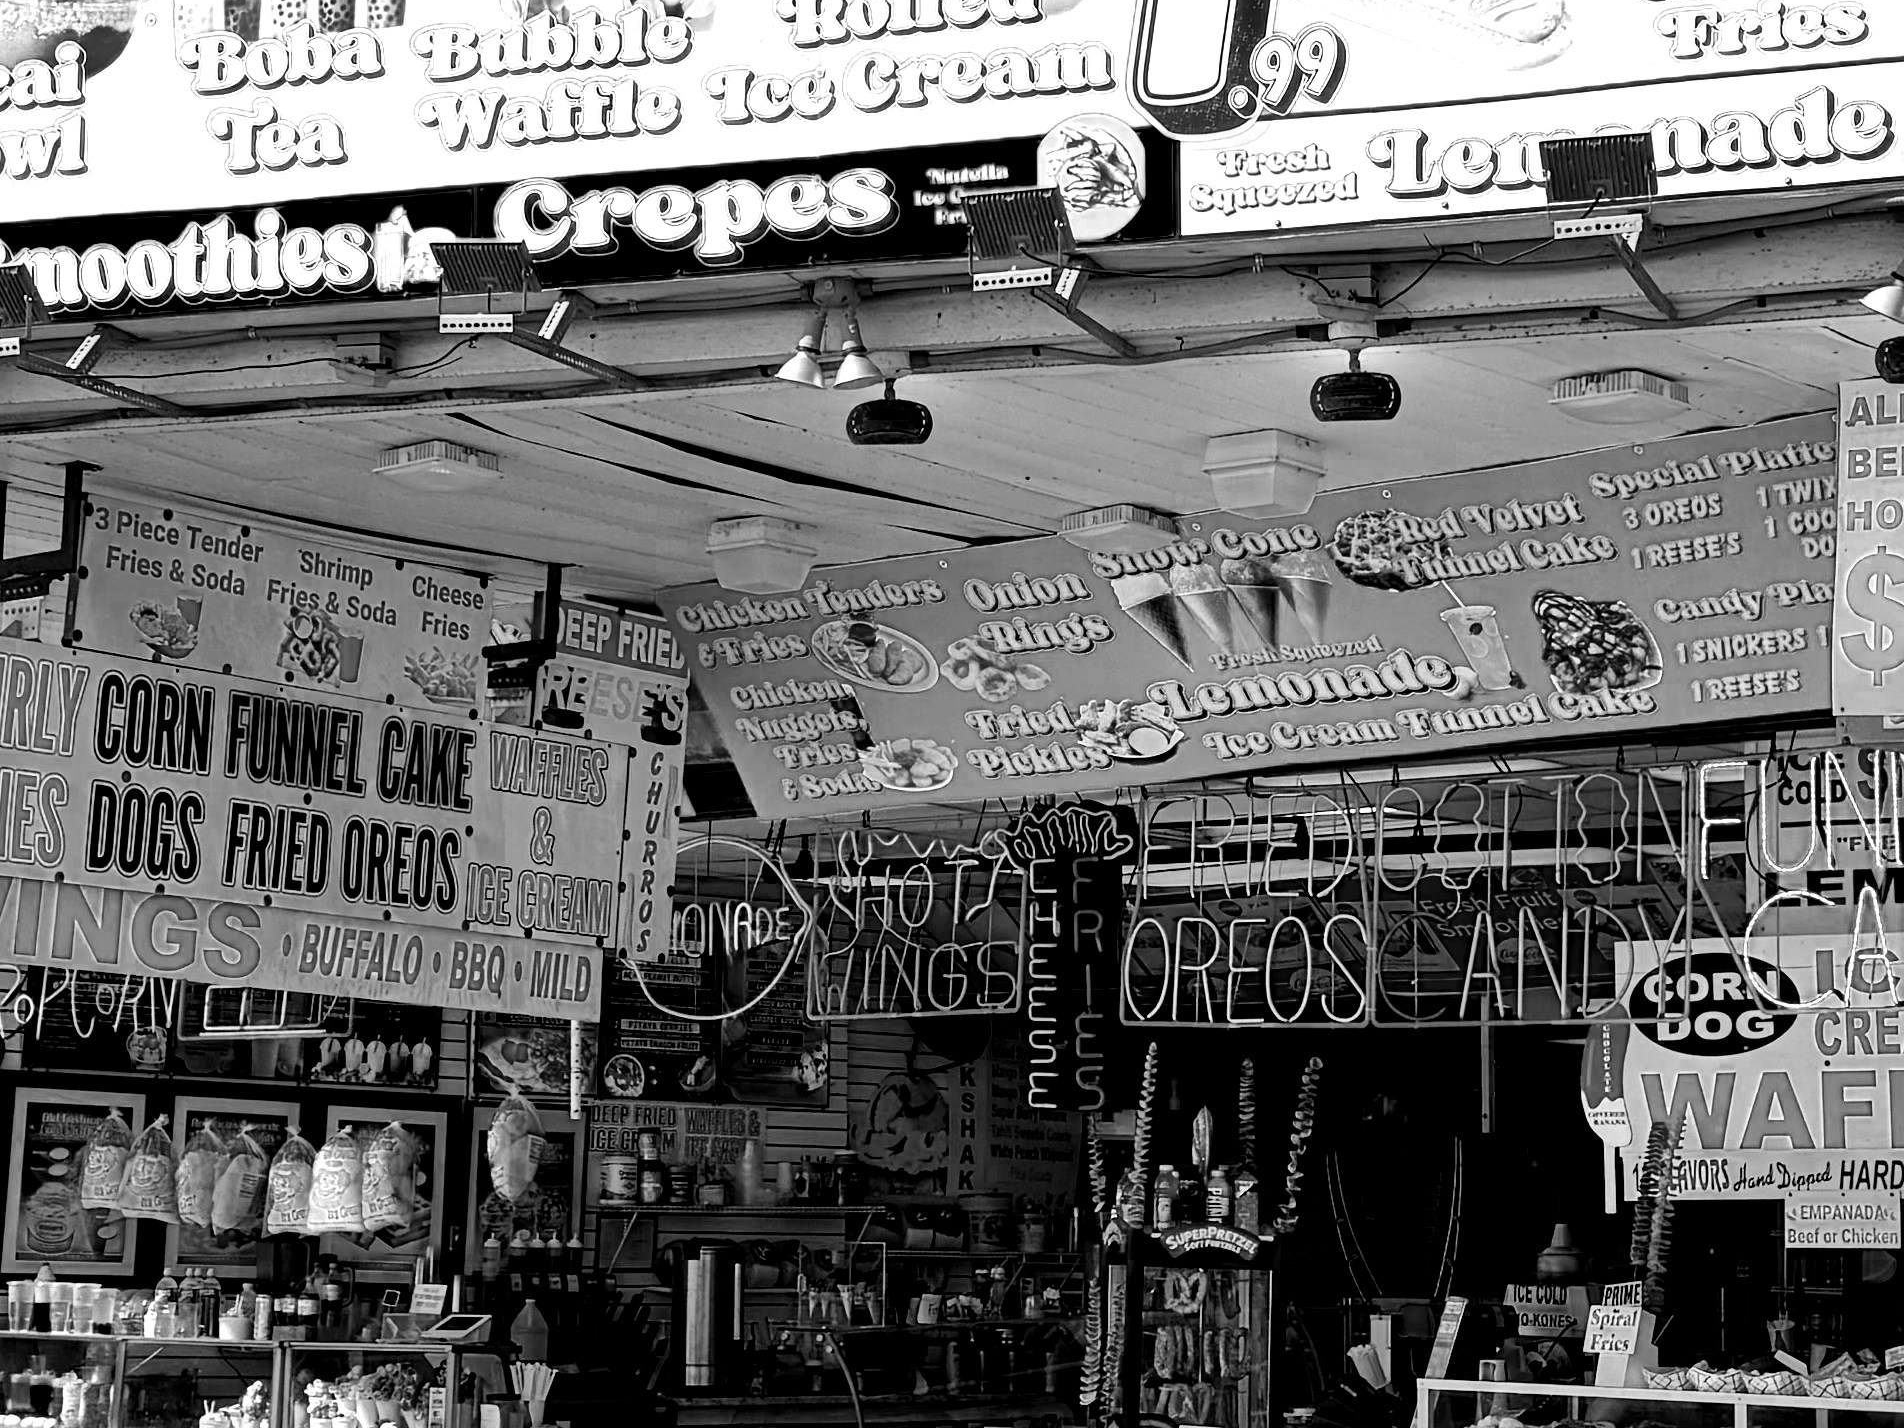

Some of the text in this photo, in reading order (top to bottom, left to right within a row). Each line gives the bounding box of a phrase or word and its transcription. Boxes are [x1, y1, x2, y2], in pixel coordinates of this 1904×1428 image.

[411, 11, 694, 86] Bubble
[1659, 0, 1873, 61] Fries
[177, 23, 388, 95] Boba
[703, 40, 1116, 126] Ice Cream
[418, 76, 683, 153] Waffle
[207, 111, 348, 175] Tea
[1217, 141, 1331, 178] Fresh
[492, 168, 898, 265] Crepes
[1189, 174, 1359, 212] Squeezed
[1587, 451, 1722, 501] Special
[94, 508, 264, 564] 3 Piece Tender
[105, 544, 246, 597] Fries & Soda
[298, 548, 375, 590] Shrimp
[411, 575, 485, 612] Cheese
[963, 573, 1094, 614] Onion
[266, 578, 397, 627] Fries & Soda
[421, 610, 471, 642] Fries
[675, 575, 947, 636] Chicken Tenders
[1652, 590, 1765, 624] Candy
[977, 611, 1115, 658] Rings
[1210, 633, 1385, 672] Fresh Squeezed
[1146, 646, 1460, 724] Lemonade
[94, 670, 215, 776] CORN
[225, 689, 367, 799] FUNNEL
[376, 716, 477, 814] CAKE
[967, 742, 1112, 783] Pickles
[488, 732, 610, 807] WAFFLES
[86, 778, 205, 883] DOGS
[222, 798, 330, 898] FRIED
[340, 817, 463, 912] OREOS
[635, 752, 665, 953] CHURROS
[466, 862, 612, 939] ICE CREAM
[300, 923, 422, 984] BUFFALO
[452, 942, 505, 1000] BBQ
[530, 953, 591, 1003] MILD
[1642, 970, 1778, 1001] CORN
[1656, 1011, 1775, 1041] DOG
[1840, 1160, 1904, 1189] HARD
[1787, 1228, 1898, 1244] Beef or Chicken
[1604, 1283, 1641, 1306] PRIME
[1591, 1309, 1637, 1330] Spiral
[1591, 1334, 1629, 1352] Fries
